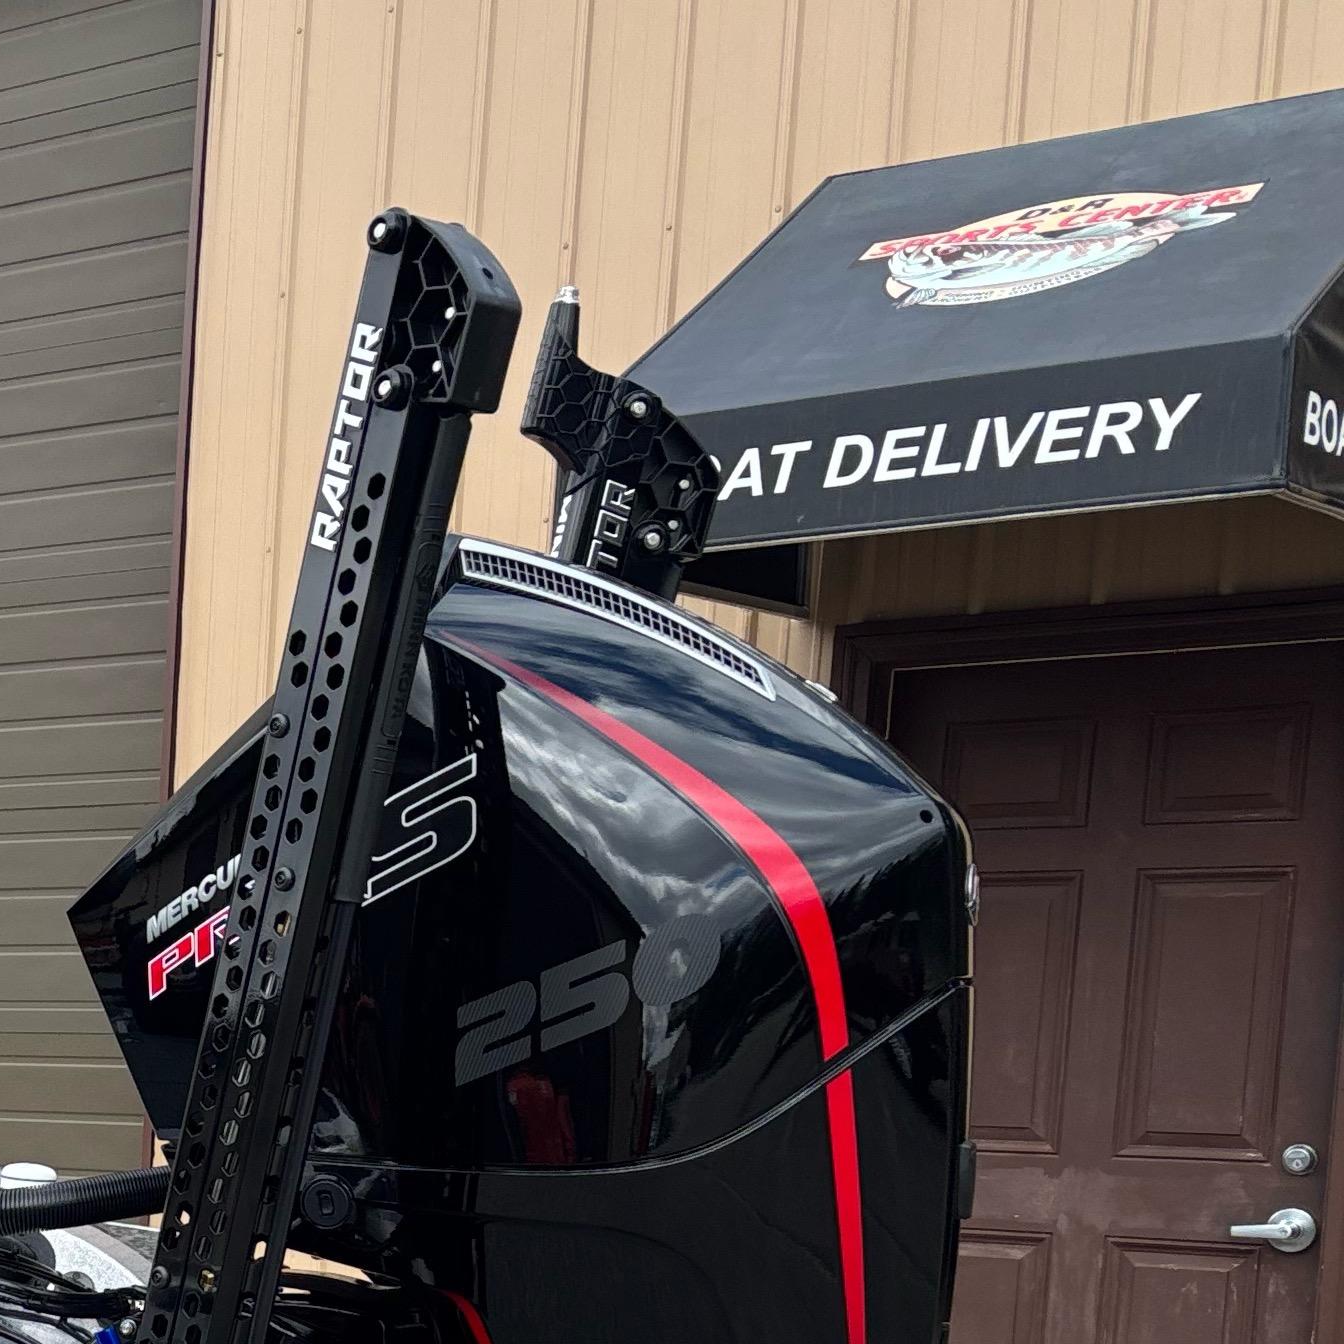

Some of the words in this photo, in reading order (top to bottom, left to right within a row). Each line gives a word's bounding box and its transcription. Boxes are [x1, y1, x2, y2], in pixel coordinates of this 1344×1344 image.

[1057, 188, 1240, 229] CENTER
[312, 322, 384, 552] RAPTOR
[709, 440, 813, 501] AT
[822, 392, 1202, 490] DELIVERY
[1303, 390, 1344, 455] BO
[585, 479, 636, 569] TOR
[145, 852, 242, 945] MERCU
[147, 904, 231, 1001] PR
[454, 912, 722, 1088] 250
